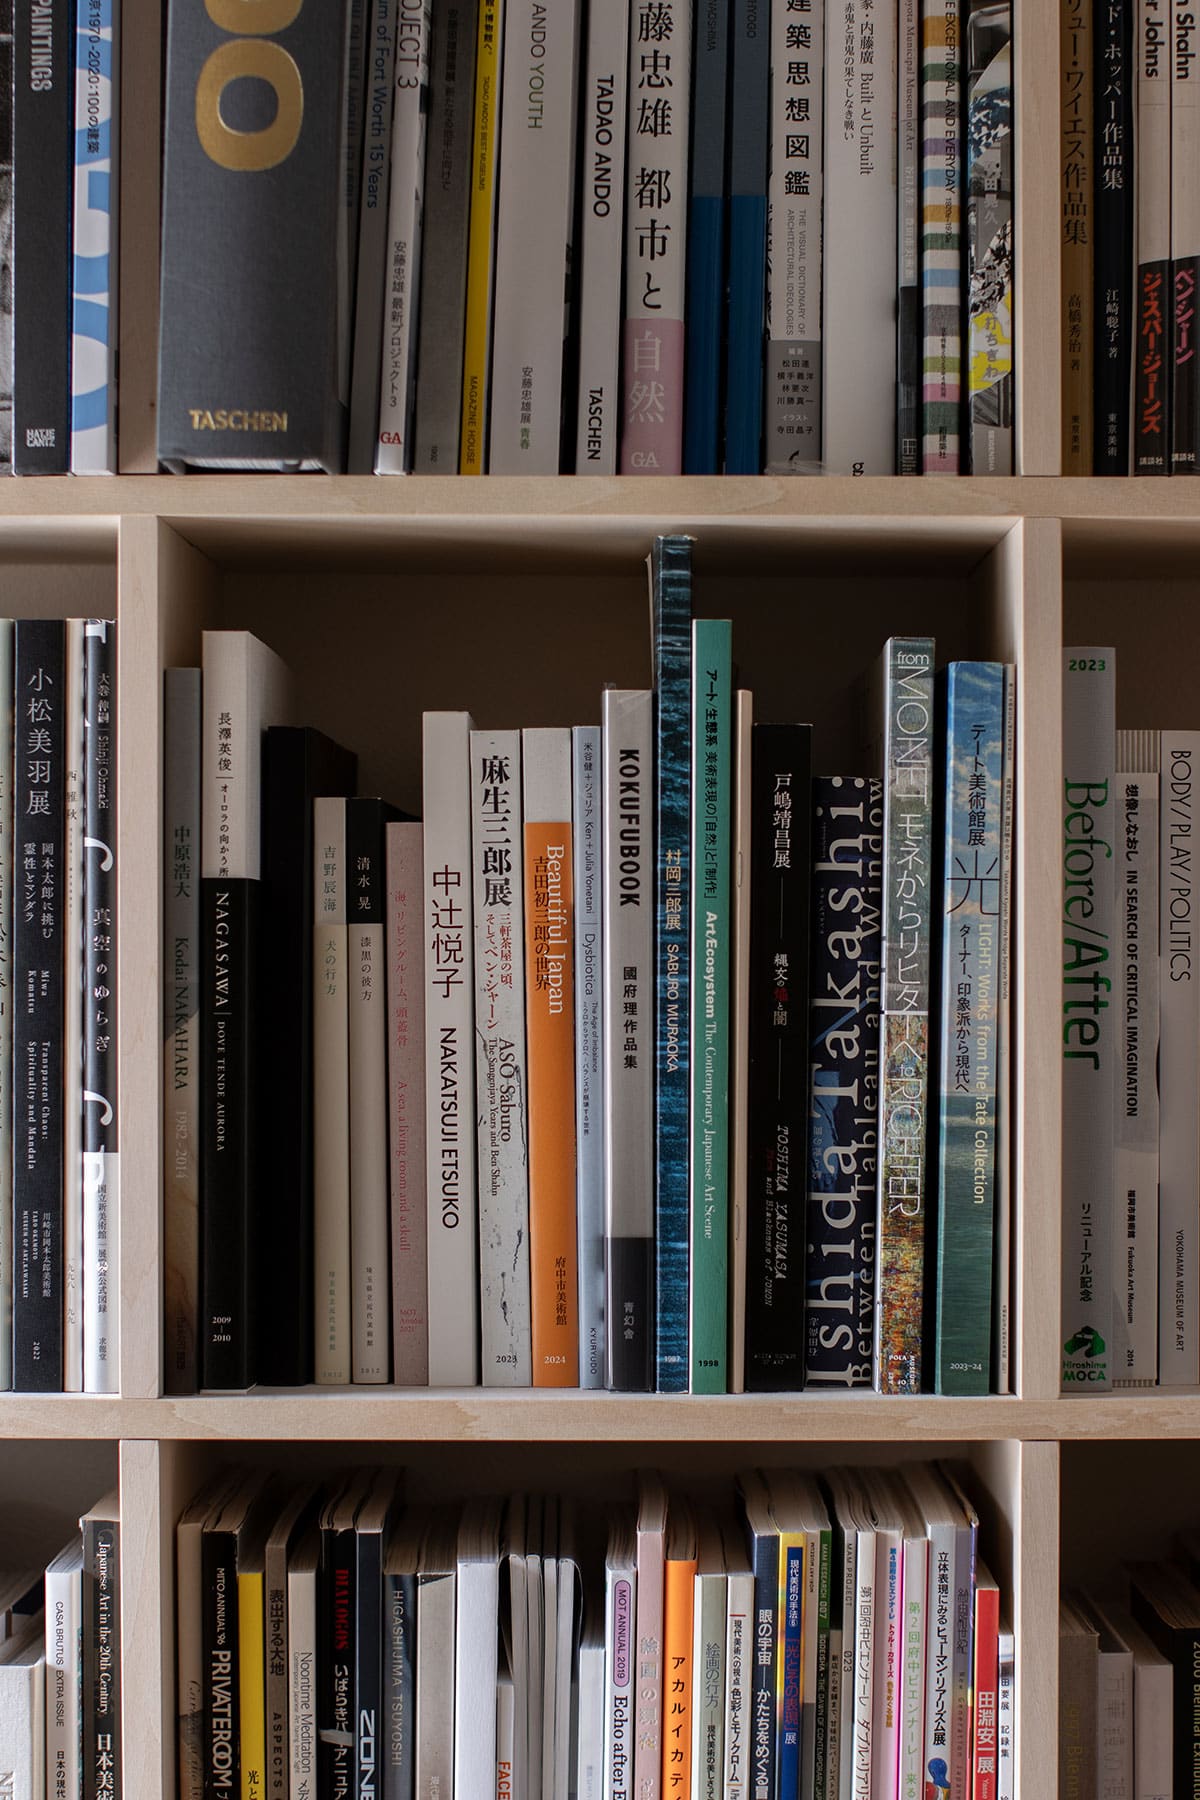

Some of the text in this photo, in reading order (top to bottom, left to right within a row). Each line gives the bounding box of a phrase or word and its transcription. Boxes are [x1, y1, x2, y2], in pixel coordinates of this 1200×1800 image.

[397, 76, 419, 89] 3
[528, 3, 547, 129] ANDO YOUTH
[904, 26, 915, 118] Municipal Museum
[1145, 18, 1163, 78] Johns
[1175, 12, 1195, 80] Shahn
[367, 47, 391, 209] Fort Worth 15 Years
[593, 74, 614, 218] TADAO ANDO
[860, 72, 874, 176] Built と Unbuilt
[945, 12, 956, 194] EXCEPTIONAL AND EVERYDAY
[392, 241, 407, 293] 安藤忠雄
[785, 209, 796, 336] ARCHITECTURAL IDEOLOGIES
[797, 209, 807, 336] THE VISUAL DICTIONARY OF
[1141, 271, 1163, 434] ジャスパー・ジョーンズ
[1174, 269, 1194, 366] ベン・シャーン
[189, 408, 288, 433] TASCHEN
[380, 431, 402, 445] GA
[466, 376, 478, 465] MAGAZINE HOUSE
[519, 365, 534, 423] 安藤忠雄展
[588, 387, 603, 461] TASCHEN
[630, 451, 660, 468] GA
[1068, 658, 1107, 672] 2023
[26, 667, 53, 817] 小松美羽展
[217, 712, 233, 772] 長澤英俊
[895, 651, 931, 809] from MONET
[173, 825, 191, 899] 中原浩大
[480, 755, 512, 907] 麻生三郎展
[618, 748, 642, 908] KOKUFUBOOK
[771, 771, 794, 870] 戸嶋靖昌展
[945, 724, 1001, 915] テート美術館展 光
[40, 842, 55, 939] 岡本太郎に挑む
[431, 864, 464, 998] 中辻悦子
[546, 843, 570, 1015] Beautiful Japan
[584, 874, 595, 914] Yonetani
[664, 848, 683, 931] 村岡三郎展
[215, 891, 231, 1008] NAGASAWA
[582, 933, 597, 997] Dysbiotica
[1125, 783, 1140, 1117] 想像しなおし IN SEARCH OF CRITICAL IMAGINATION
[174, 986, 188, 1091] NAKAHARA
[622, 965, 638, 1070] 國府理作品集
[664, 943, 680, 1074] SABURO MURAOKA
[40, 1040, 52, 1102] Transparent
[215, 1020, 226, 1153] DOVE TENDE AURORA
[487, 1037, 500, 1197] The Years and Ben Shahn
[498, 1083, 517, 1142] Saburo
[702, 910, 720, 1239] Art/Ecosystem Contemporary Art Scene
[438, 1026, 460, 1230] NAKATSUJI ETSUKO
[887, 1077, 924, 1218] RICHTER
[973, 1129, 989, 1205] Collection
[773, 1123, 790, 1281] TOSHIMA YASUMASA
[850, 1047, 880, 1384] Between Tableau
[805, 1140, 860, 1389] Ishida
[1126, 1246, 1136, 1324] Fukuoka Art Museum
[1175, 1228, 1187, 1353] YOKOHAMA MUSEUM ART
[210, 1316, 232, 1325] 2009
[210, 1334, 232, 1343] 2010
[544, 1355, 567, 1365] 2024
[698, 1360, 719, 1368] 1998
[1062, 1360, 1107, 1369] Hiroshima
[1062, 1370, 1107, 1382] MOCA
[215, 1566, 226, 1632] MITO ANNUAL
[819, 1543, 829, 1562] MAM
[819, 1562, 828, 1599] RESEARCH
[96, 1541, 114, 1715] Japanese Art in the 20th Century
[268, 1589, 285, 1677] 表出する大地
[616, 1588, 628, 1680] MOT ANNUAL 2019
[843, 1543, 854, 1673] MAM PROJECT 023
[55, 1601, 66, 1727] CASA BRUTUS EXTRA ISSUE
[391, 1589, 404, 1766] HIGASHIJIMA TSUYOSHI
[704, 1641, 721, 1710] 絵画の行方
[272, 1711, 283, 1788] ASPECTS
[300, 1651, 315, 1775] Noontime Meditation
[612, 1695, 628, 1787] Echo after
